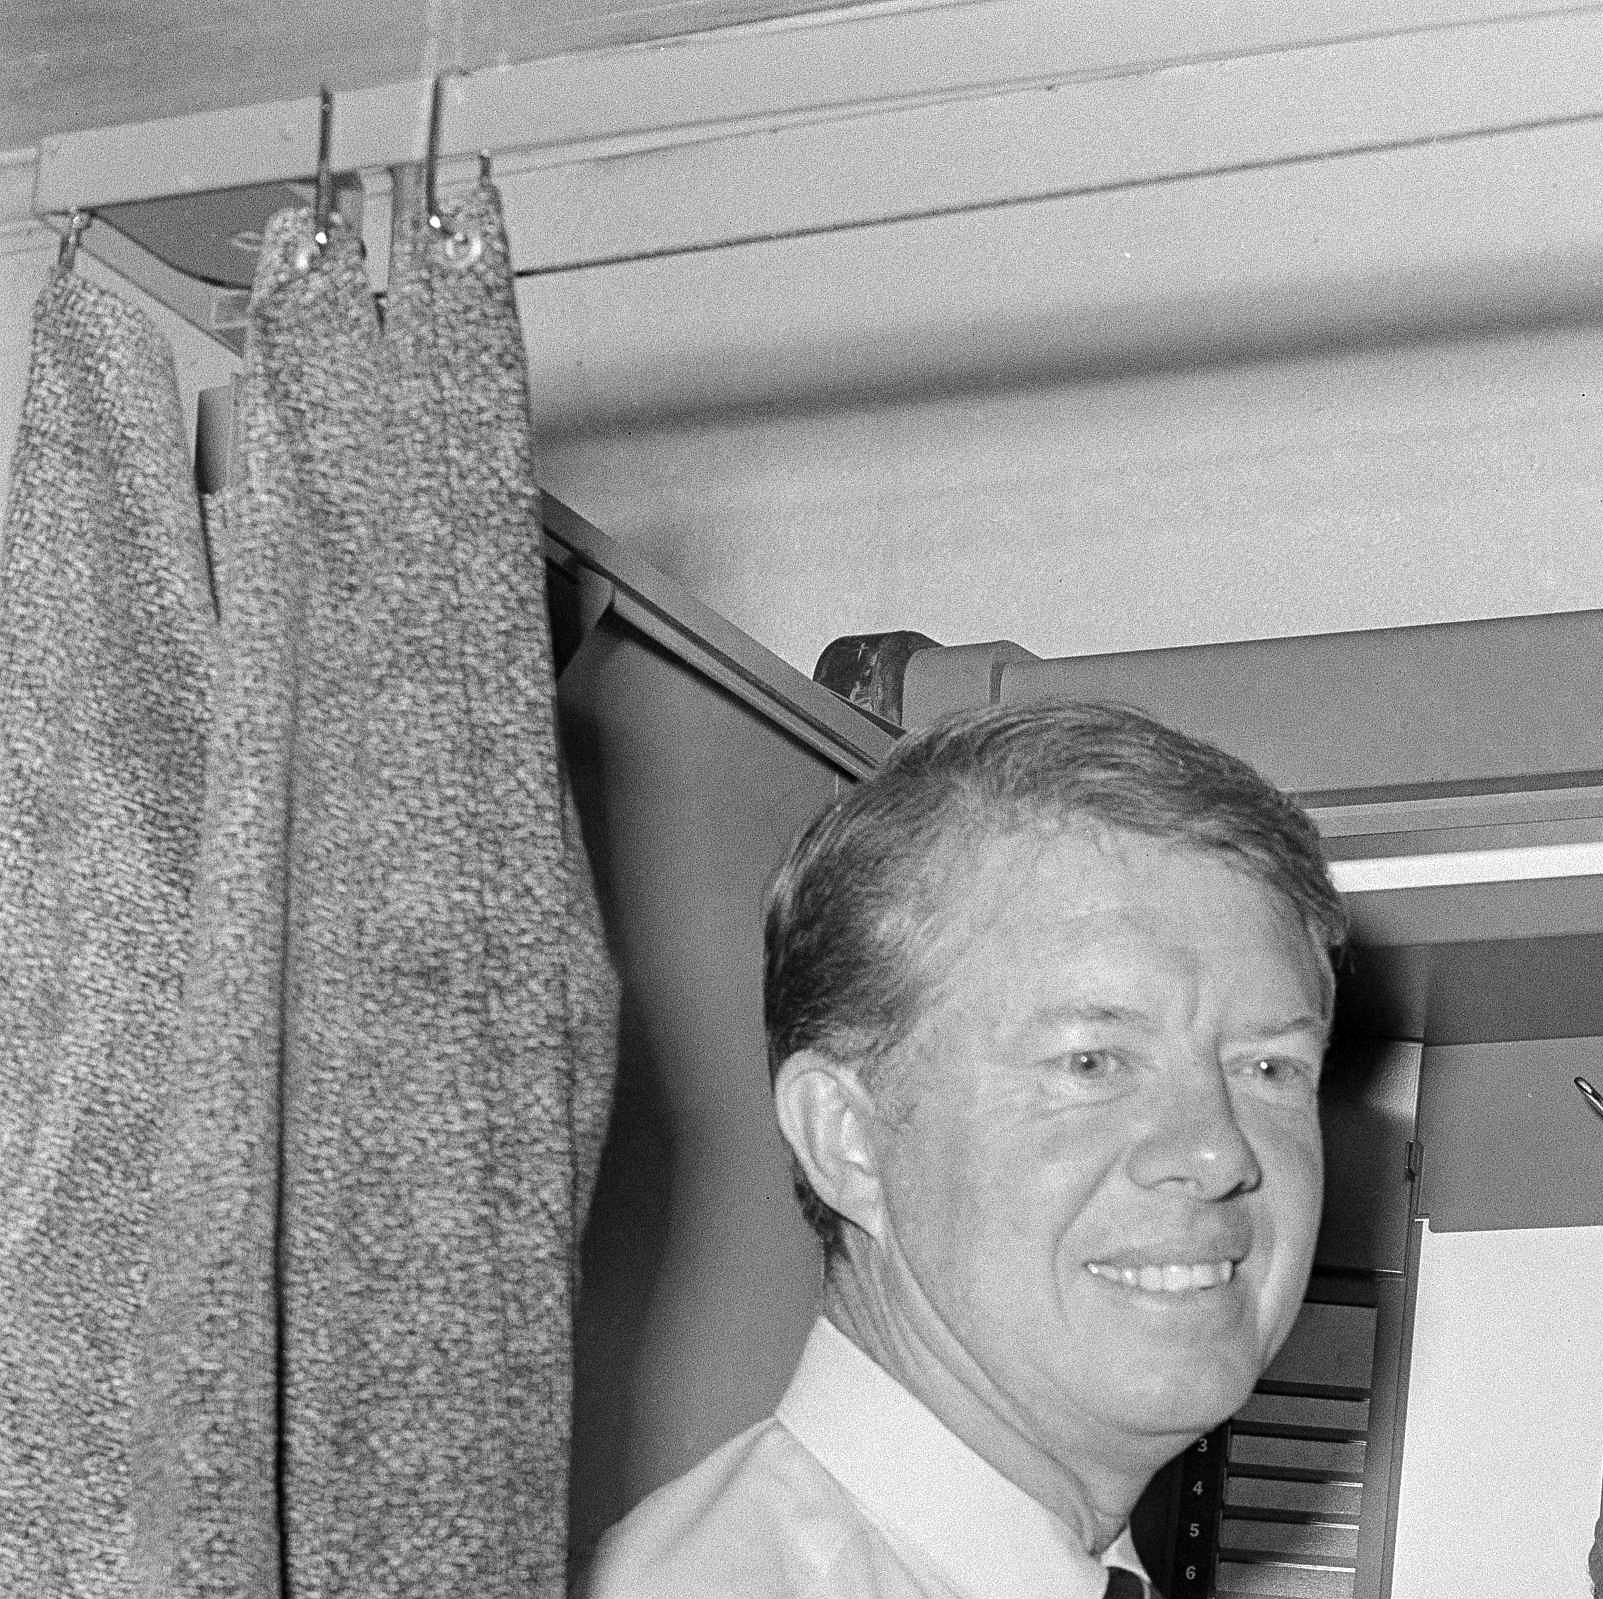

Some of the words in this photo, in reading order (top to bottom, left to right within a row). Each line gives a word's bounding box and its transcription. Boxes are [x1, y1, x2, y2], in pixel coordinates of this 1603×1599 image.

[1198, 1438, 1208, 1452] 3
[1193, 1481, 1203, 1495] 4
[1190, 1523, 1200, 1537] 5
[1185, 1566, 1196, 1580] 6
